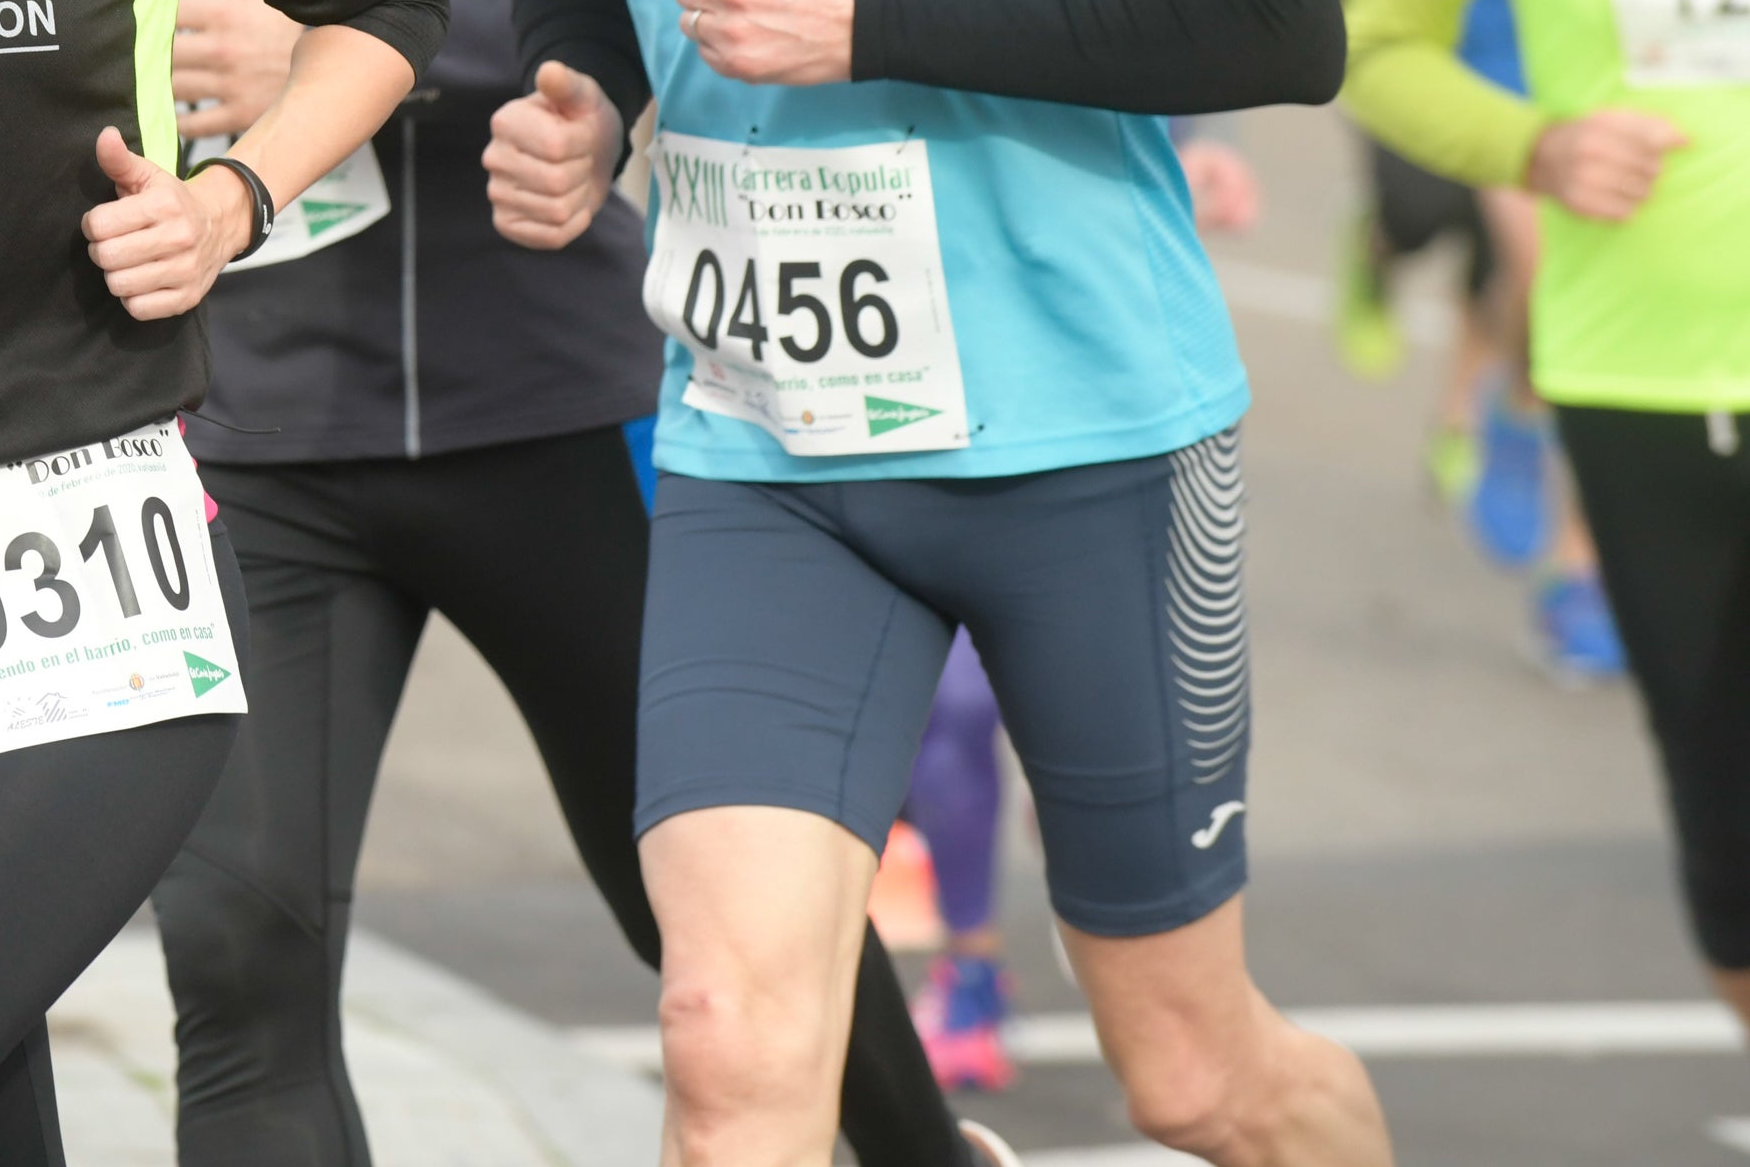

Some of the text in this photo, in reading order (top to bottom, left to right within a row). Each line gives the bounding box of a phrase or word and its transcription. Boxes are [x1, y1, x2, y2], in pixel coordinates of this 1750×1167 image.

[664, 151, 912, 228] XXIII Carrera Popular
[683, 248, 899, 363] 0456
[7, 446, 93, 485] "Don
[41, 653, 61, 669] en
[65, 647, 80, 664] el
[85, 636, 137, 661] barrio,
[142, 630, 178, 646] como
[180, 627, 193, 640] en
